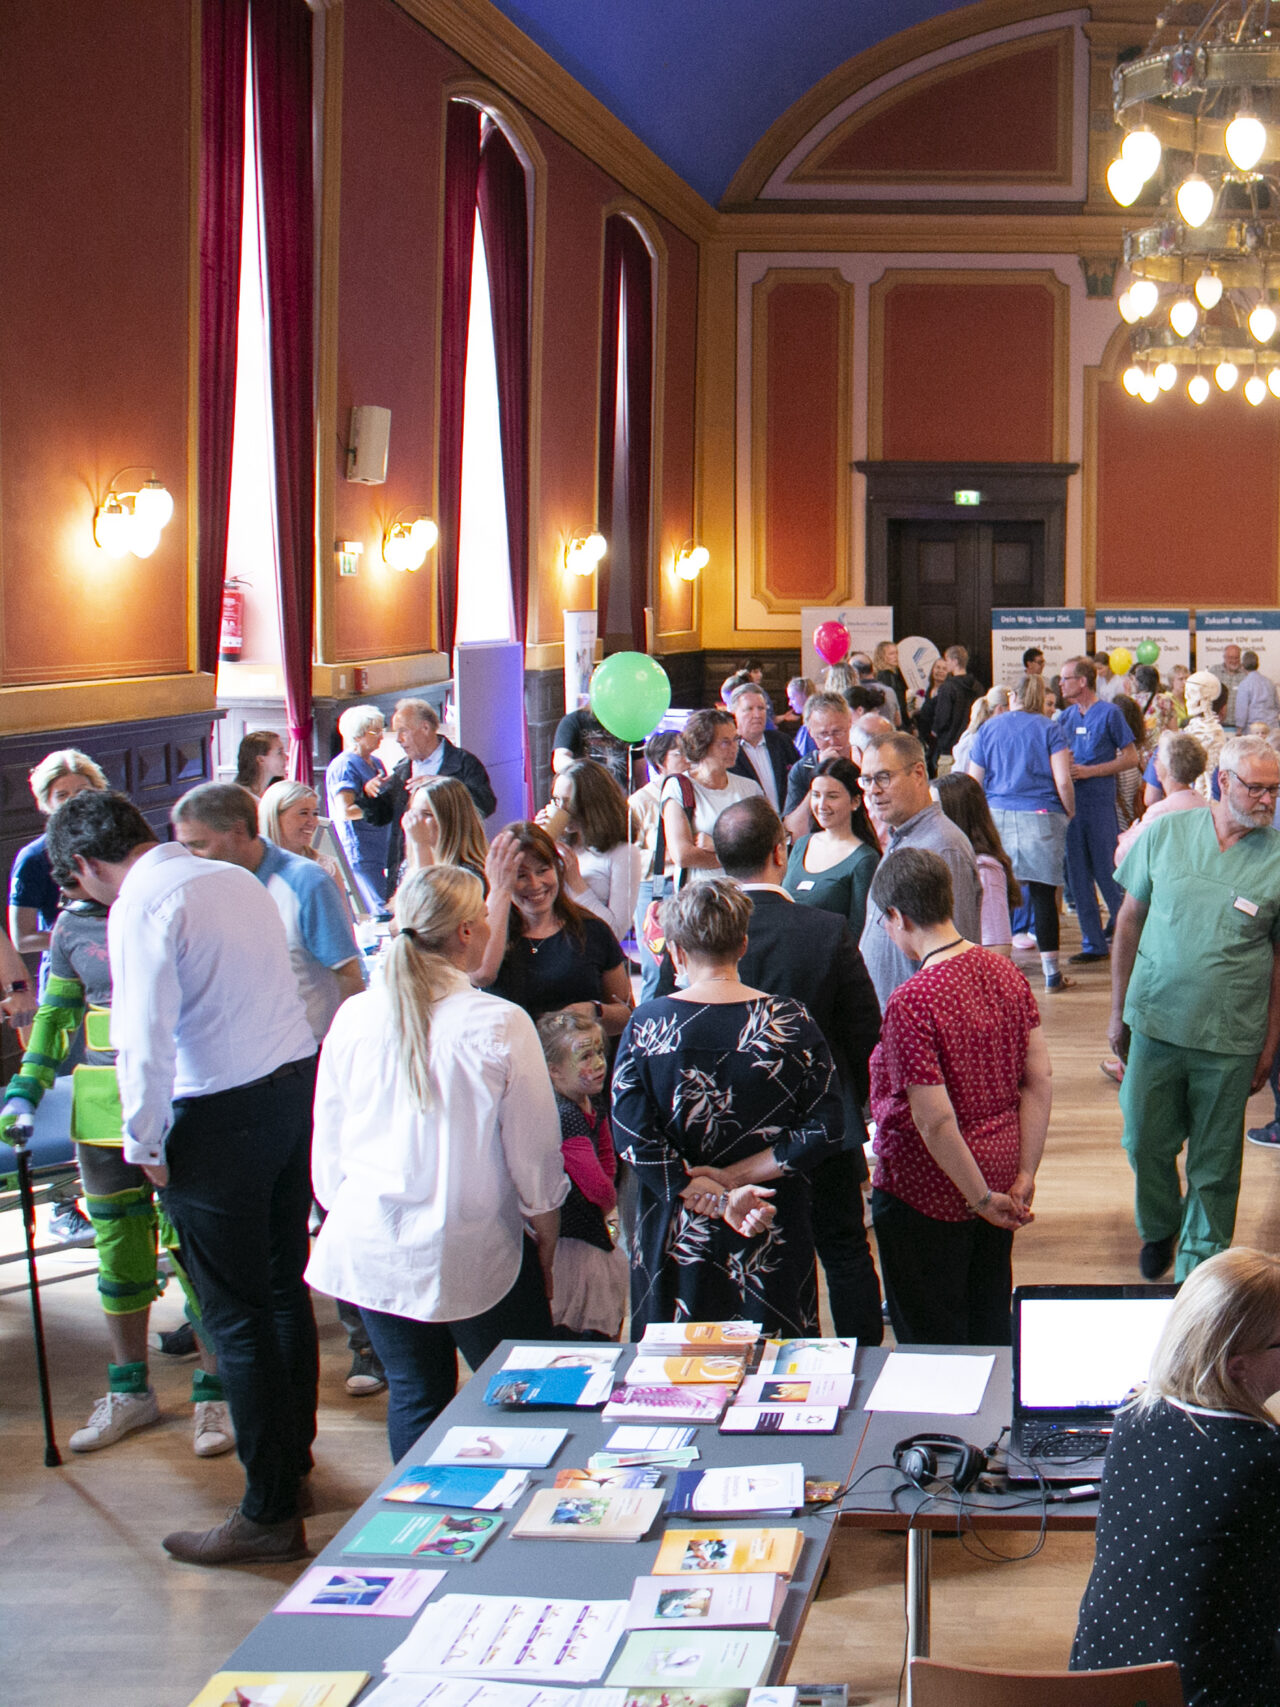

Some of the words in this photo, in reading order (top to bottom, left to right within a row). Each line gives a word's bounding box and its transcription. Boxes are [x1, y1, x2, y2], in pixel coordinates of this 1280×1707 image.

[1000, 615, 1016, 623] Dein
[1016, 615, 1034, 624] Weg.
[1035, 615, 1055, 623] Unser
[1104, 615, 1116, 623] Wir
[1117, 615, 1139, 623] bilden
[1140, 615, 1155, 623] Dich
[1204, 616, 1230, 624] Zukunft
[1231, 616, 1242, 624] mit
